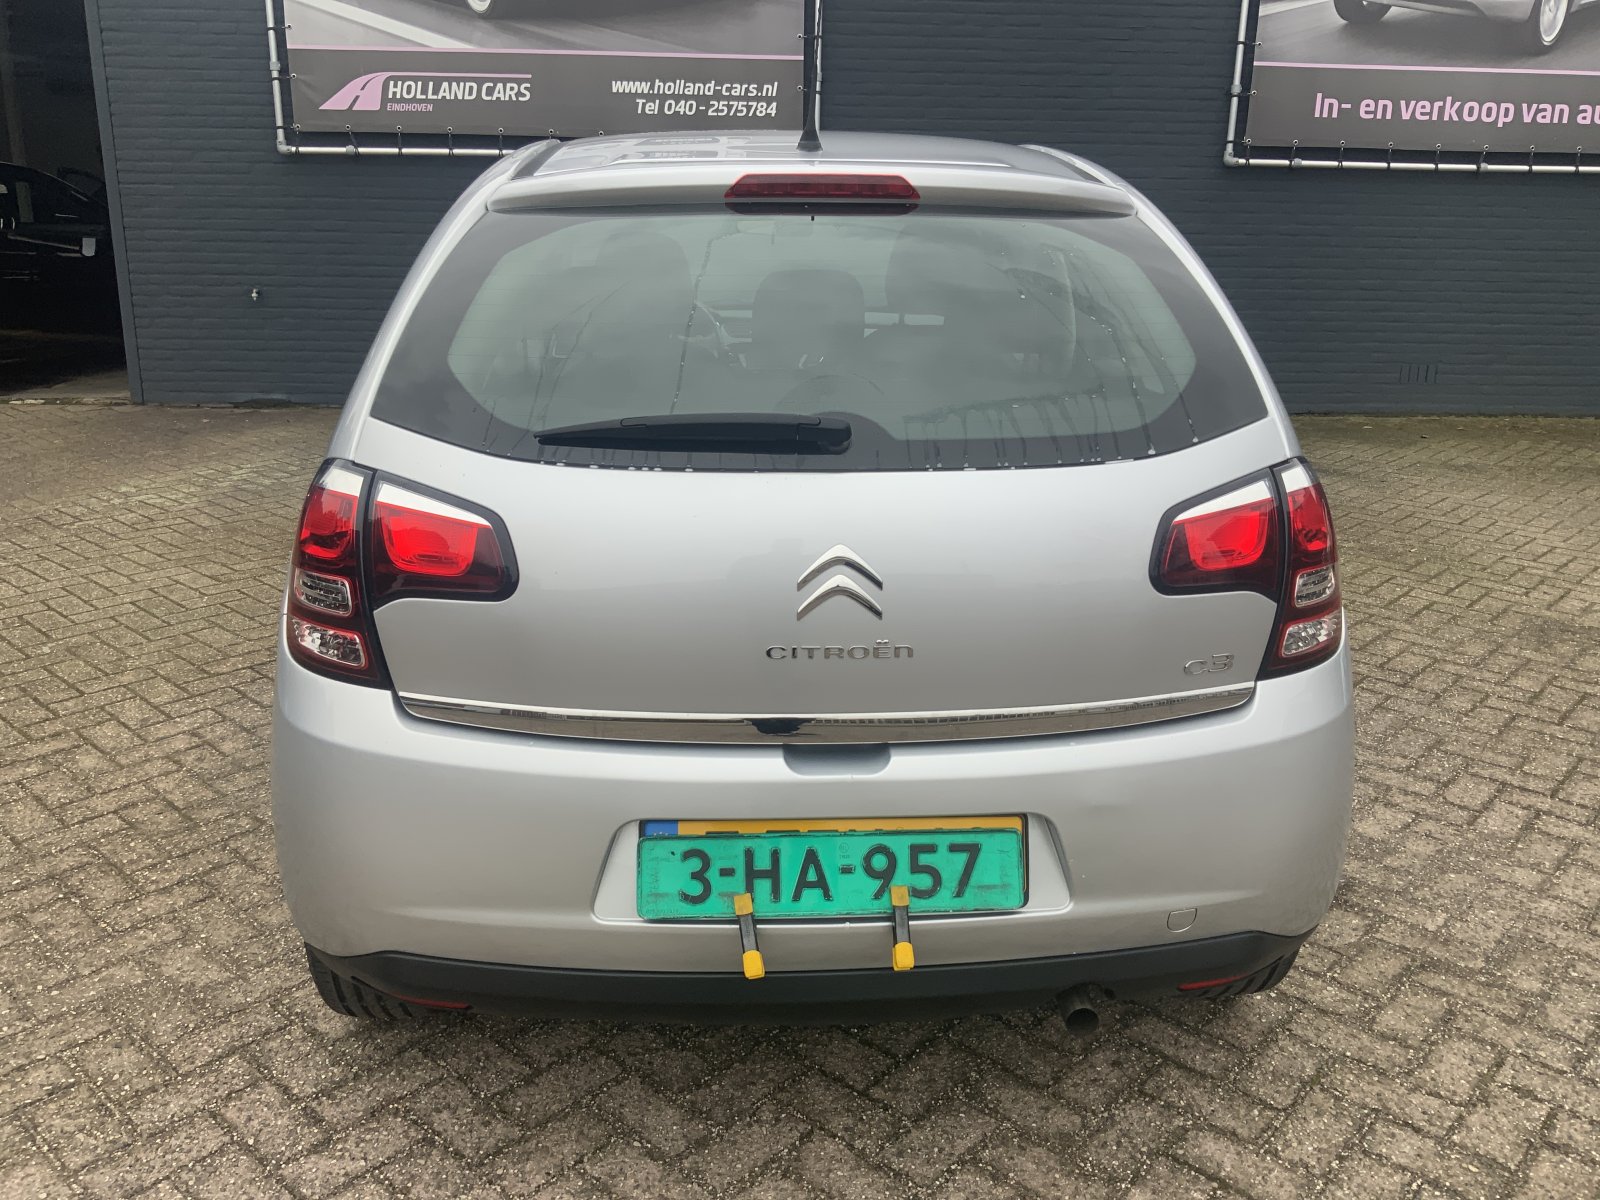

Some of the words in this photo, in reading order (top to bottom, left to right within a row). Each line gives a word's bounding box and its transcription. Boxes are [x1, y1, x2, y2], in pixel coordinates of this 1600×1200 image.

[387, 80, 478, 100] HOLLAND
[481, 82, 532, 102] CARS
[611, 79, 778, 97] www.holland-cars.nl
[387, 102, 434, 113] EINDHOVEN
[636, 98, 660, 115] Tel
[1314, 92, 1352, 119] In-
[1359, 98, 1393, 120] en
[1400, 96, 1515, 128] verkoop
[1521, 102, 1570, 125] van
[1184, 653, 1235, 676] C3
[678, 842, 983, 906] 3-HA-957
